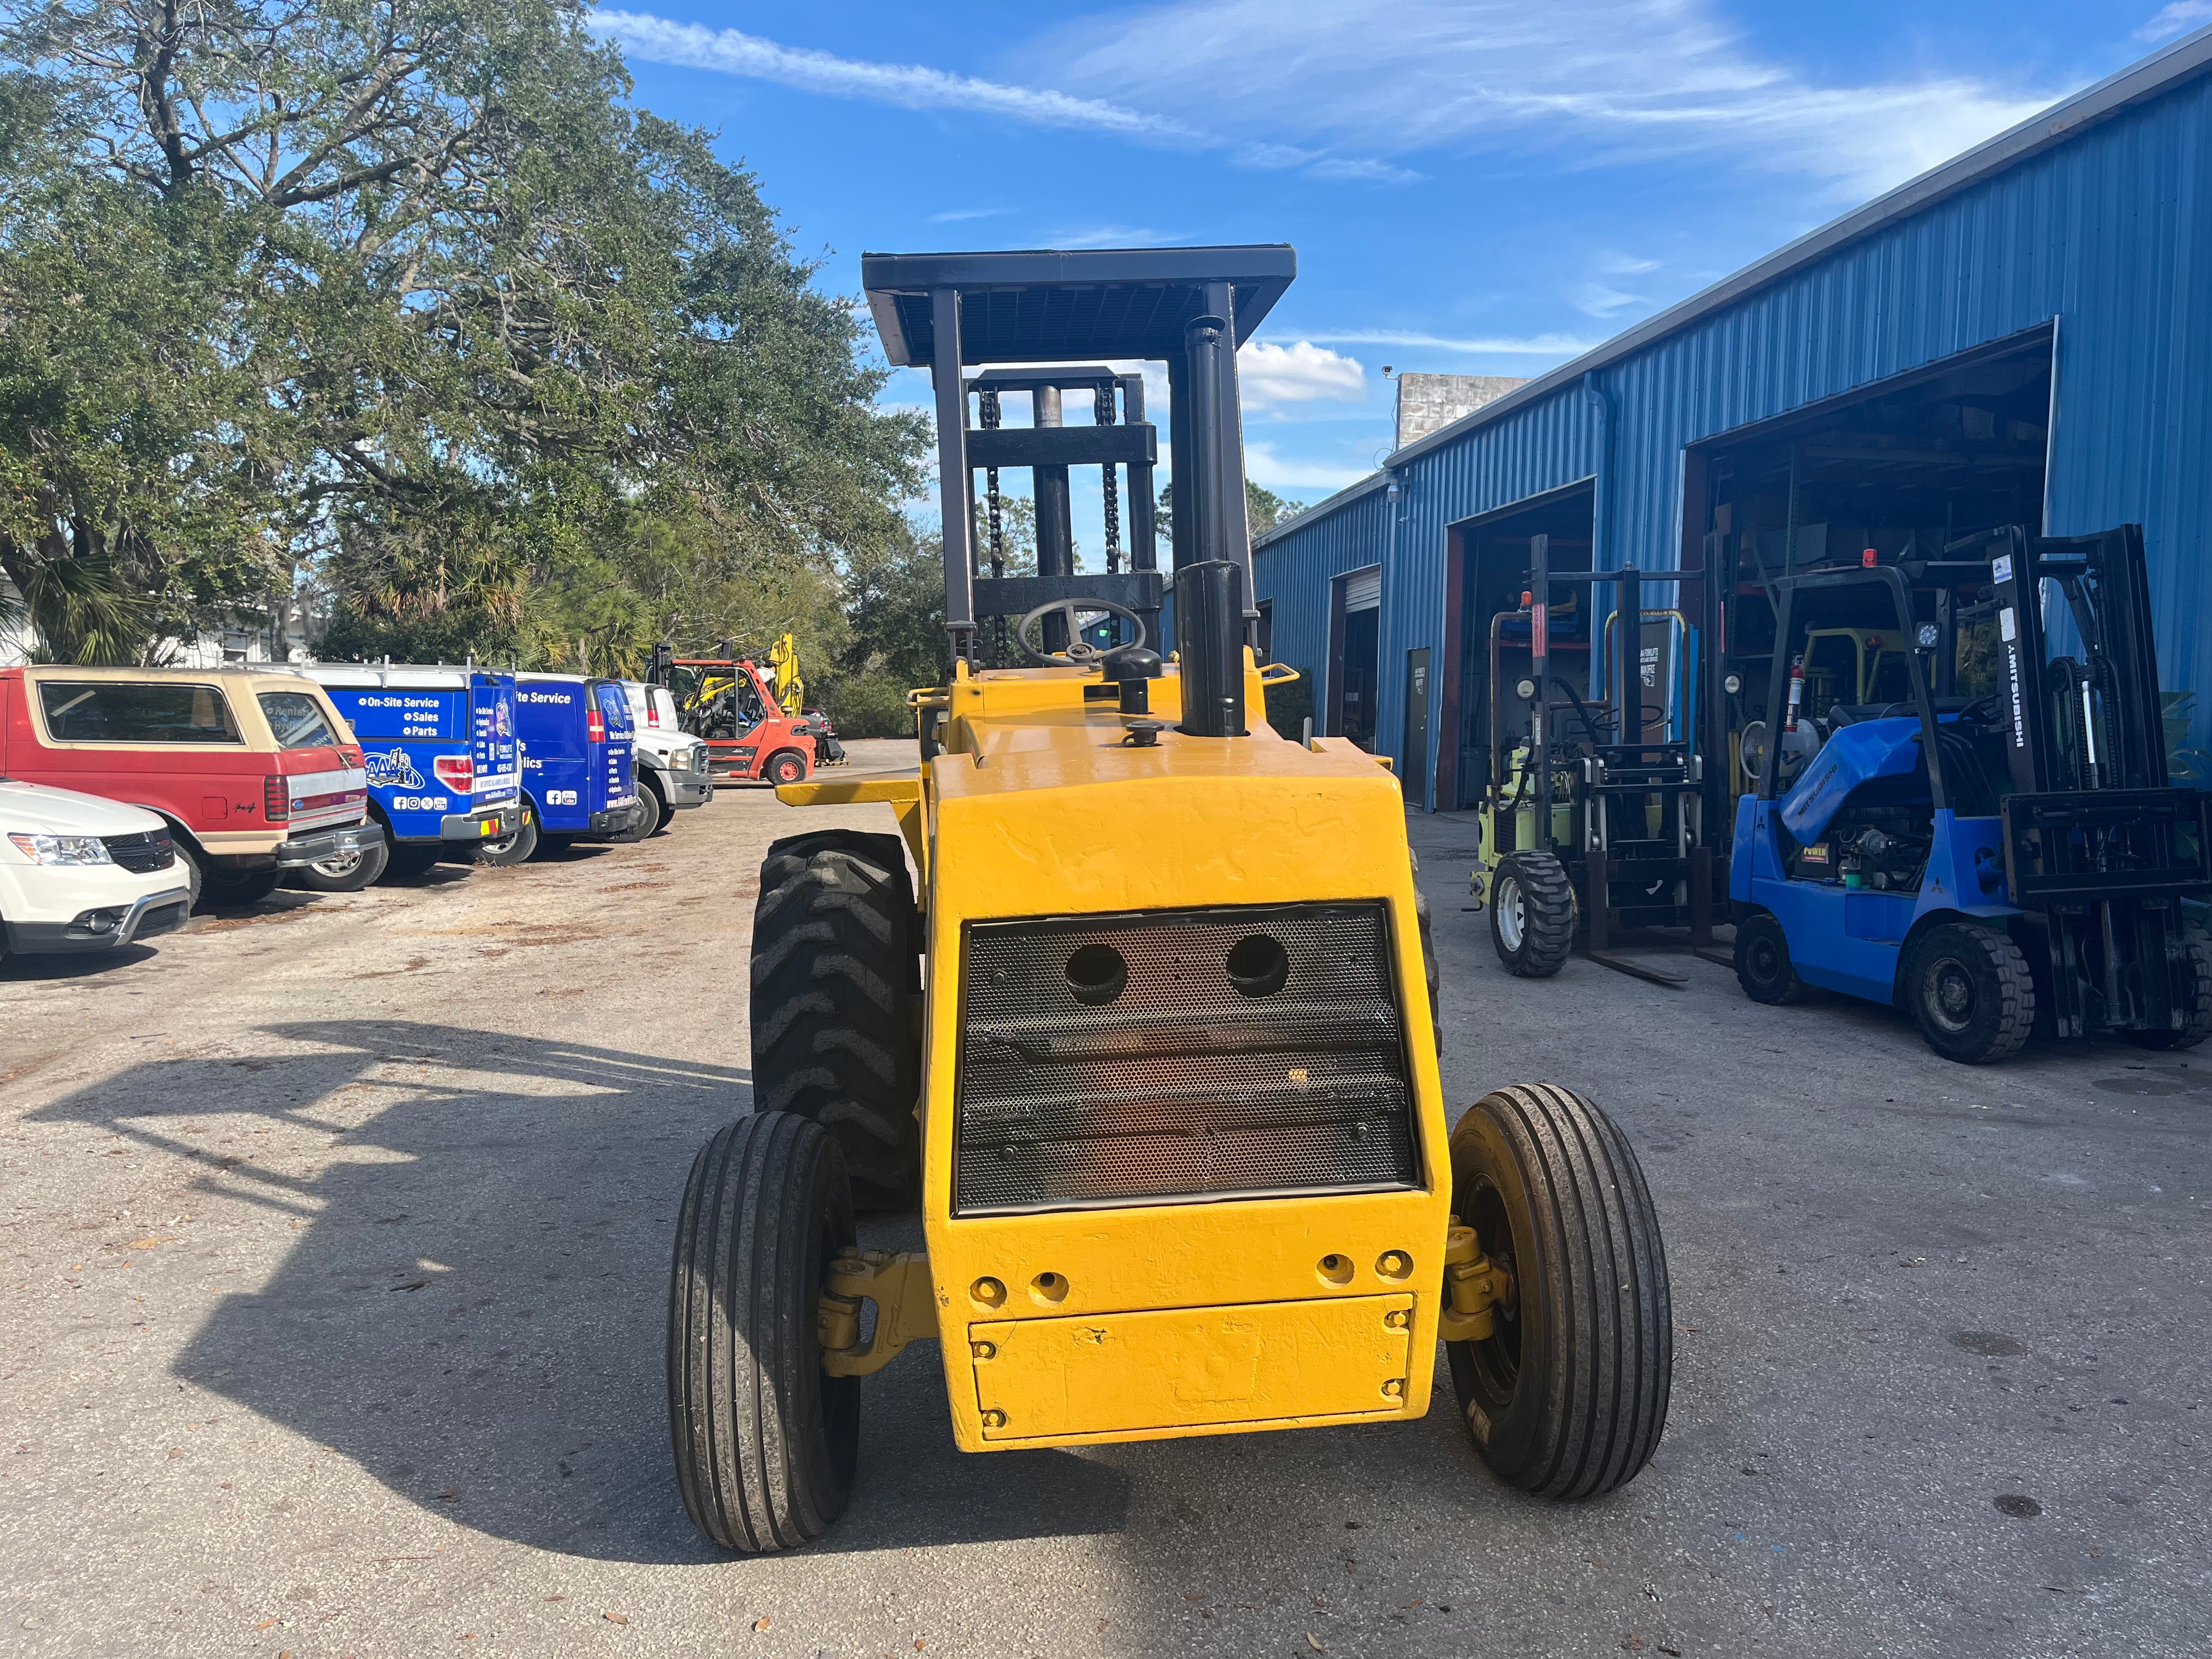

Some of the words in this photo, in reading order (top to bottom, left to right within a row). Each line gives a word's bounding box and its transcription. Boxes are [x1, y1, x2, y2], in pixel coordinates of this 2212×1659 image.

[368, 697, 402, 707] On-Site
[404, 697, 439, 708] Service
[530, 692, 571, 704] Service
[2008, 654, 2024, 748] MITSUBISHI
[413, 712, 439, 722] Sales
[412, 726, 437, 736] Parts
[1797, 763, 1838, 819] MITSUBISHI
[1803, 847, 1826, 856] POWER
